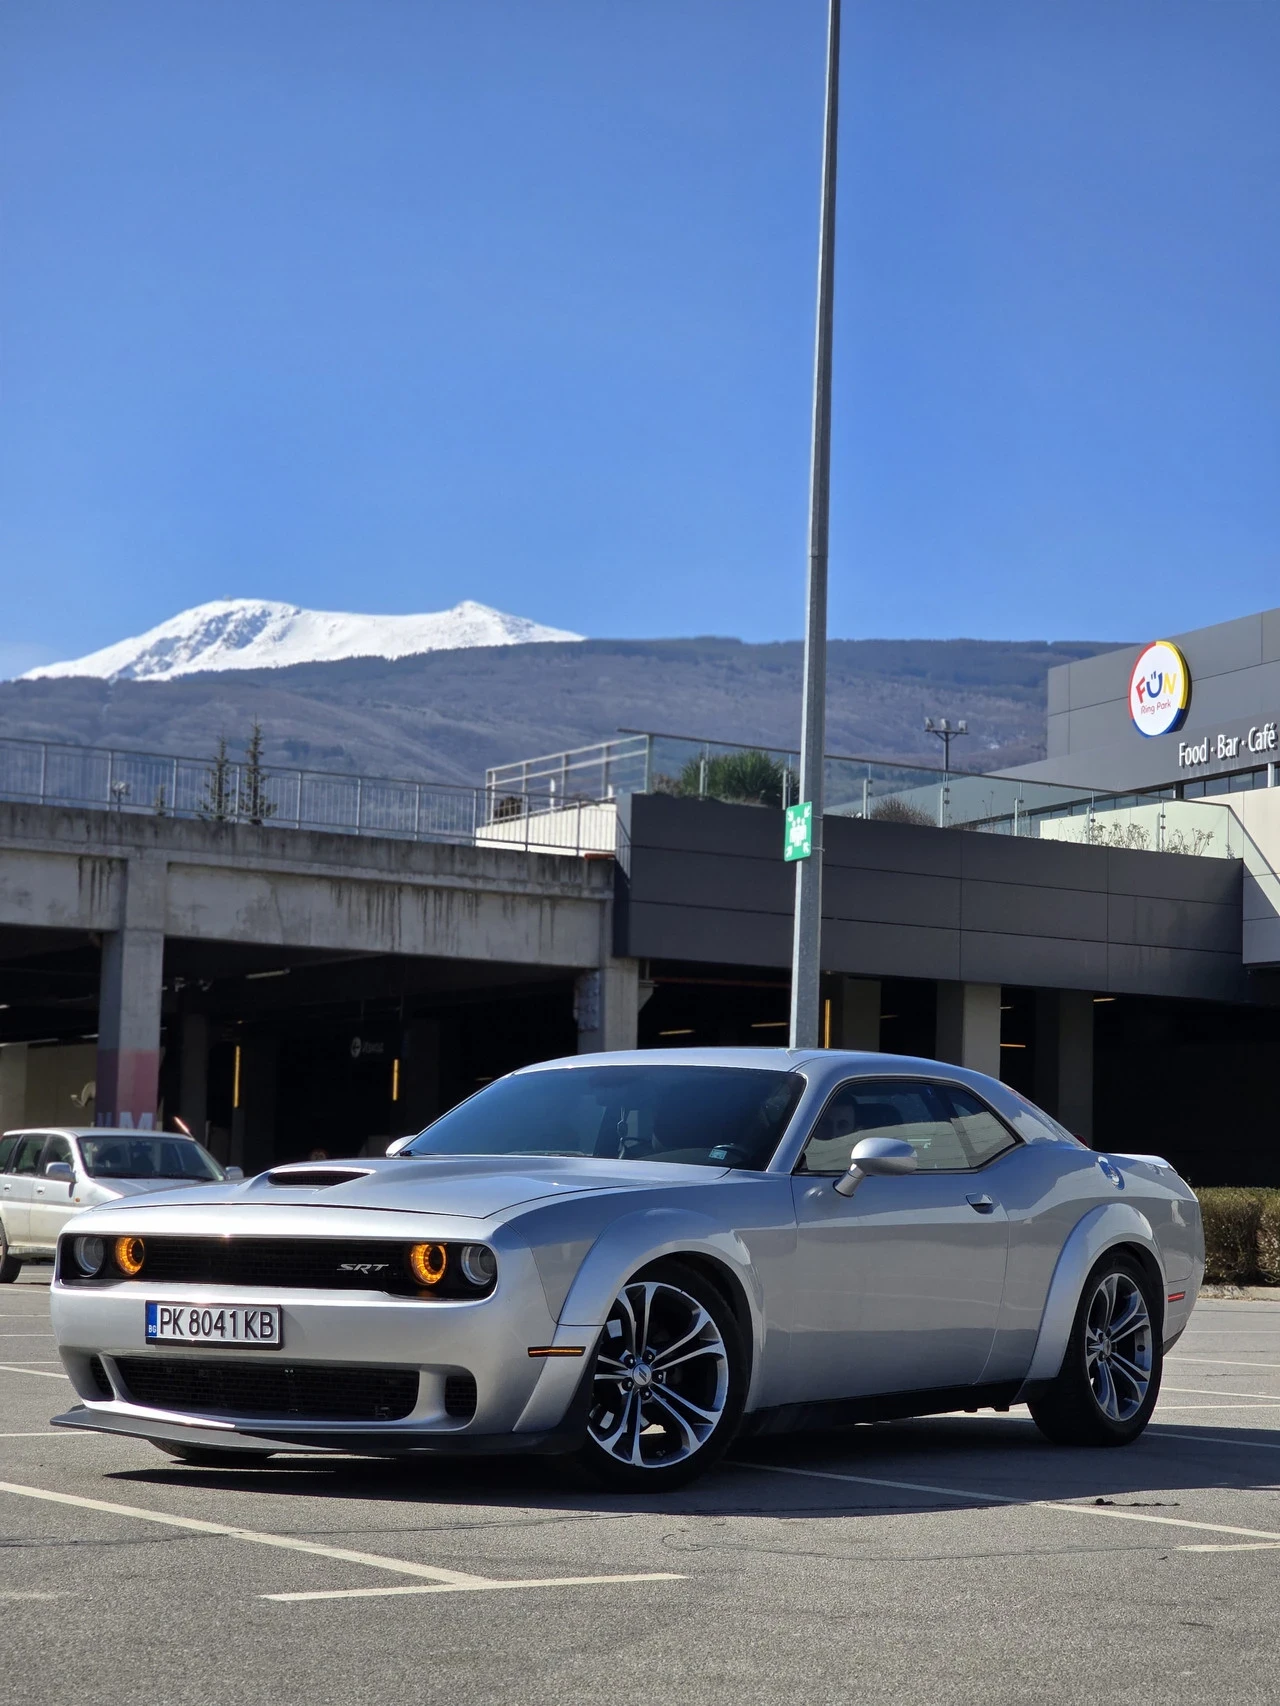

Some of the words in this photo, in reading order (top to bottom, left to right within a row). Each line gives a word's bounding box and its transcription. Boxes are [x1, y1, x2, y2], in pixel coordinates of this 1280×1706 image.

[1140, 705, 1155, 715] Ring
[1156, 700, 1172, 711] Park
[1179, 736, 1208, 767] Food
[1217, 734, 1240, 759] Bar
[1247, 722, 1276, 752] Café
[336, 1263, 390, 1275] SRT
[148, 1324, 157, 1334] BG
[160, 1307, 185, 1336] PK
[188, 1308, 238, 1338] 8041
[244, 1310, 275, 1339] KB
